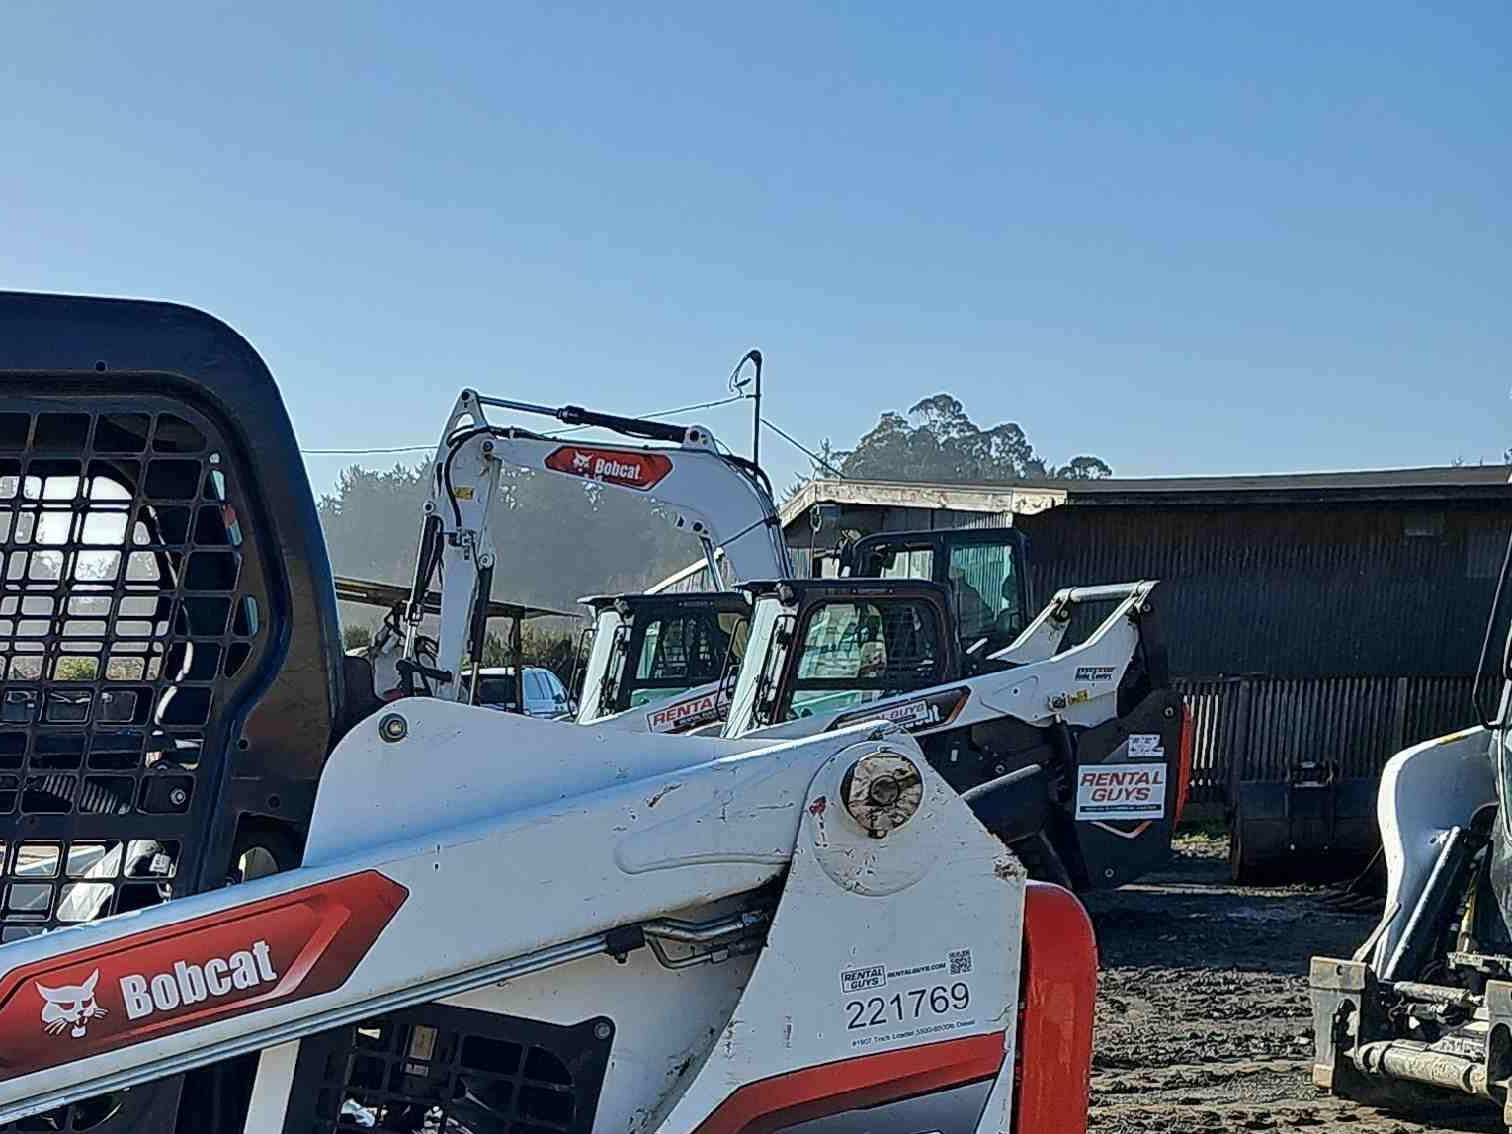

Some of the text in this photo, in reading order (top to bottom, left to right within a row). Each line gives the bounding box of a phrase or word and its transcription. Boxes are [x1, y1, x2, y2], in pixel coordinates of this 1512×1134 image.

[595, 458, 643, 480] Bobcat
[653, 697, 713, 726] RENTA
[1080, 771, 1164, 786] RENTAL
[1091, 787, 1151, 801] GUYS
[120, 940, 277, 1020] Bobcat
[844, 967, 883, 982] RENTAL
[850, 977, 879, 990] GUYS
[846, 982, 969, 1030] 221769
